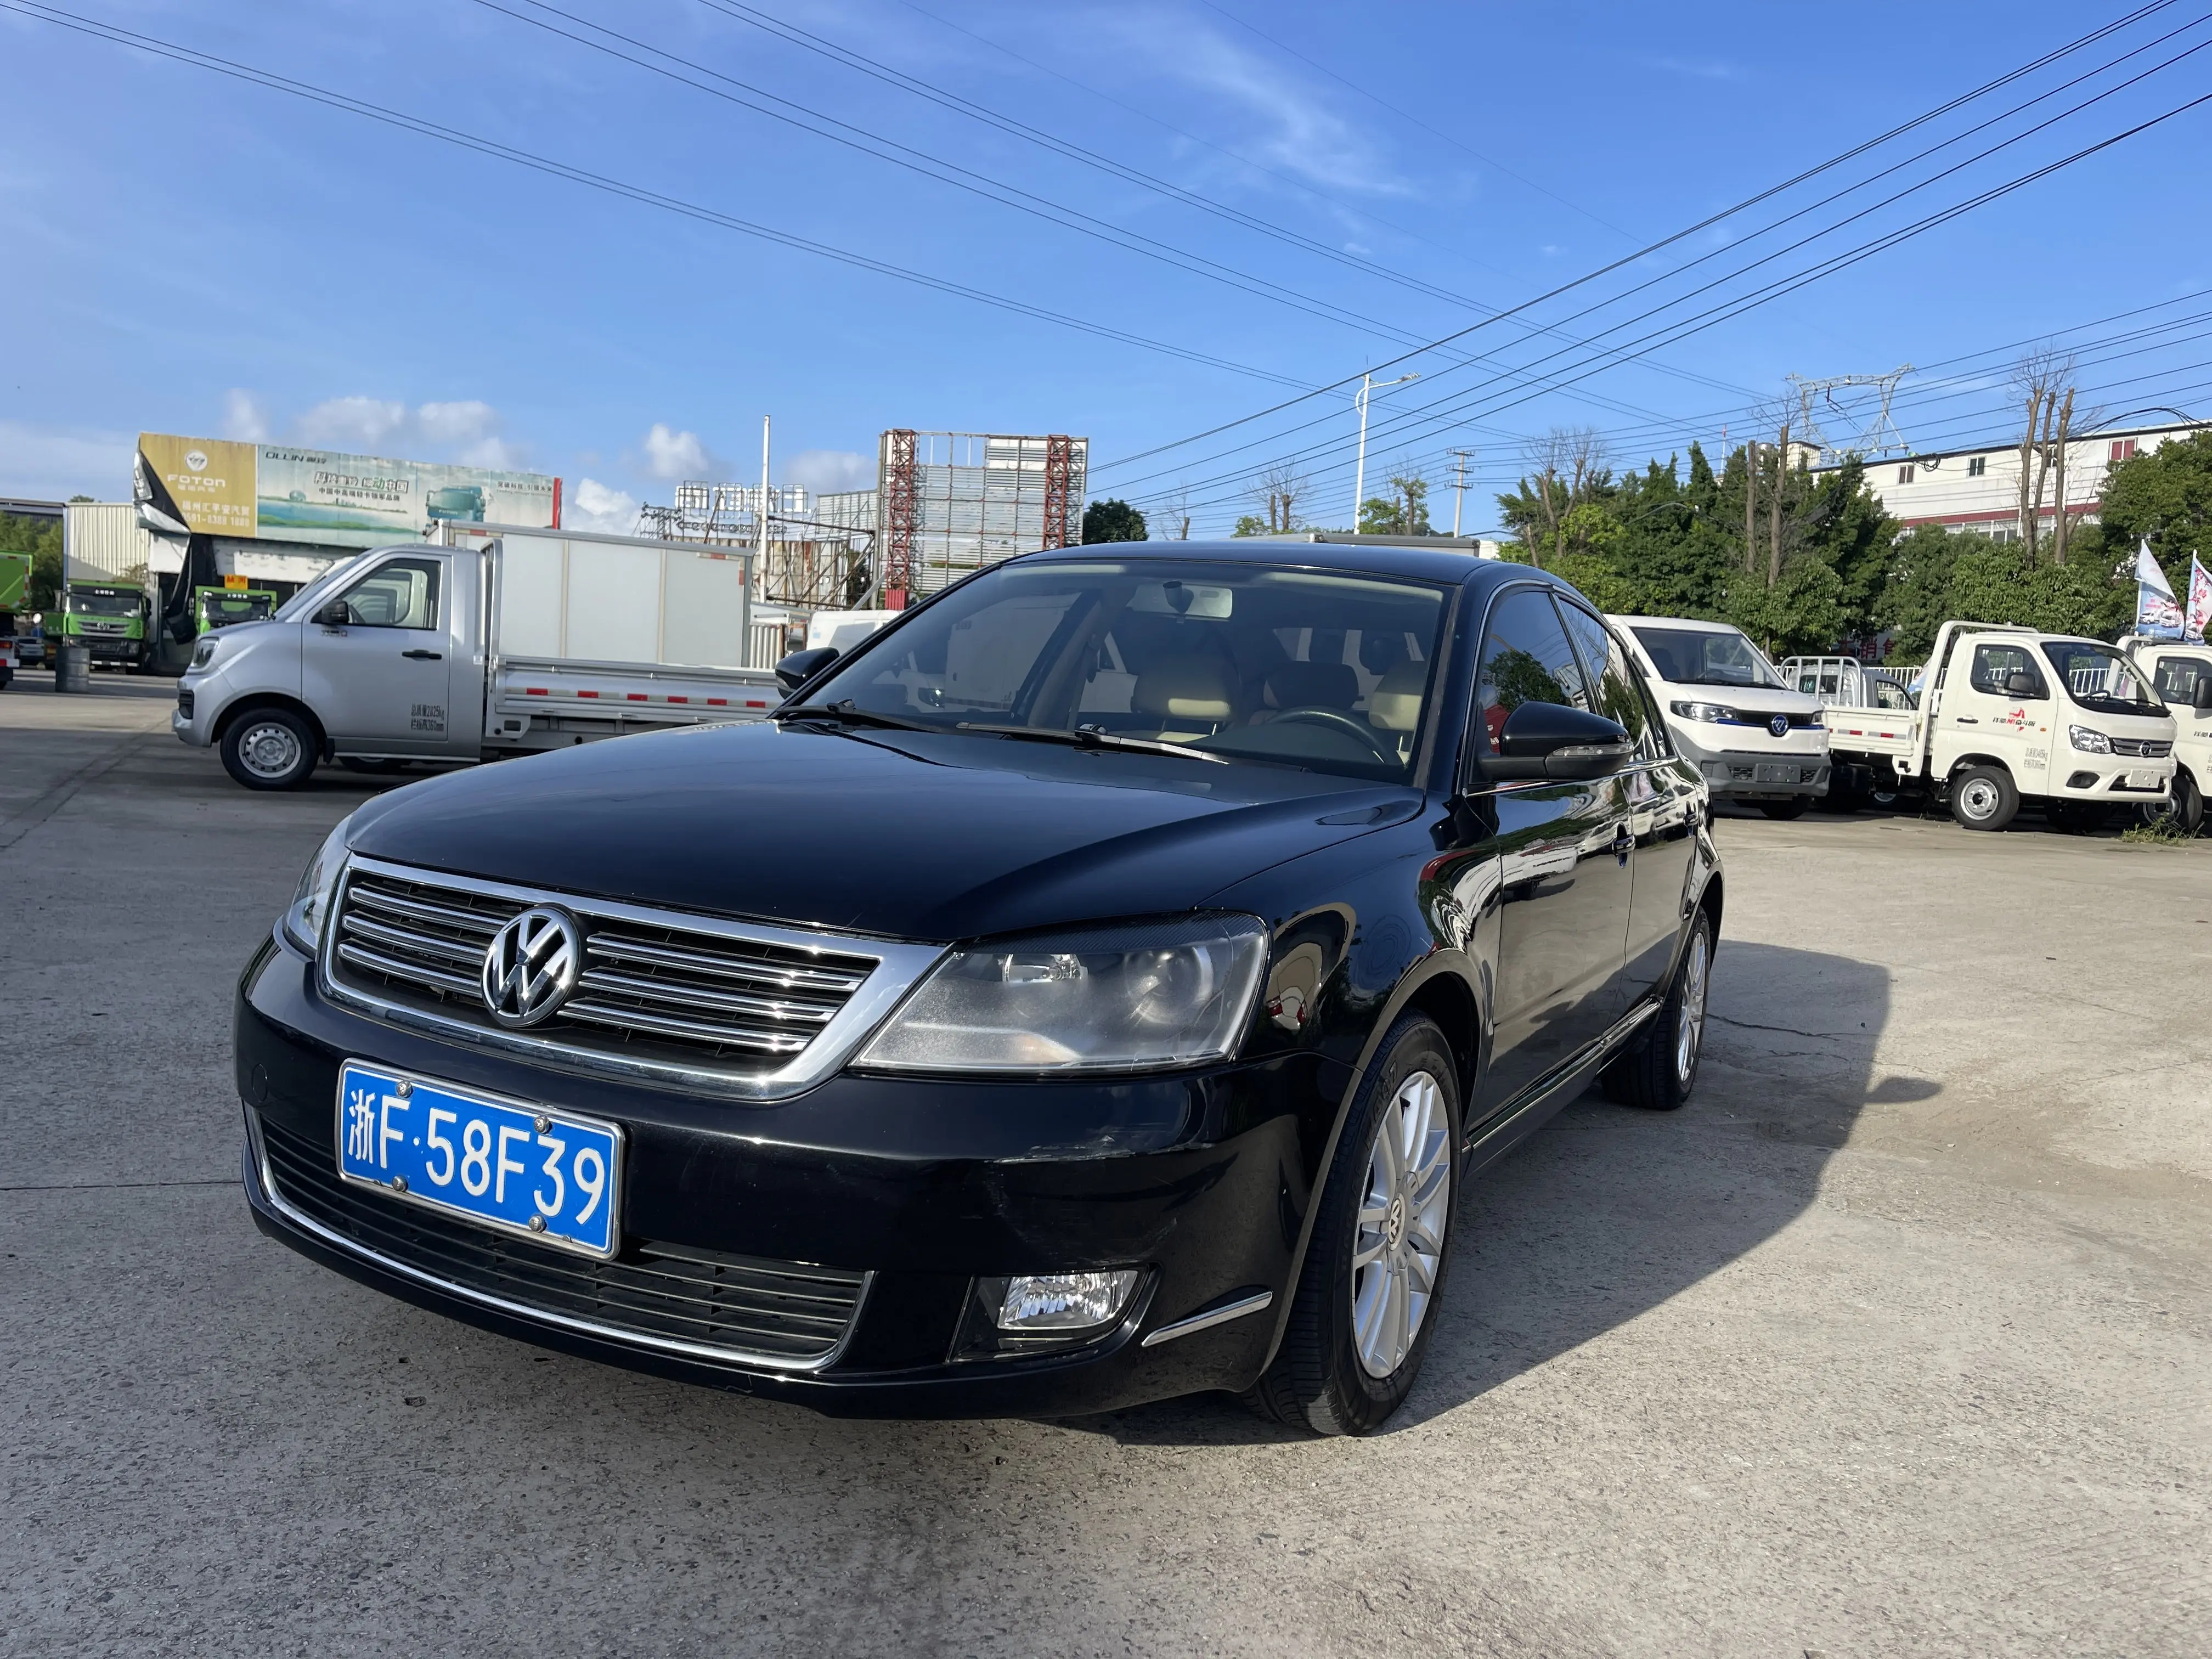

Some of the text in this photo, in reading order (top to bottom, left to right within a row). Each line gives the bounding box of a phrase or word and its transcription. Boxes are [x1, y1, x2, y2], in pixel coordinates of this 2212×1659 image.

[266, 452, 304, 462] OLLIN
[167, 474, 226, 488] FOTON
[348, 1088, 605, 1225] 浙F·58F39
